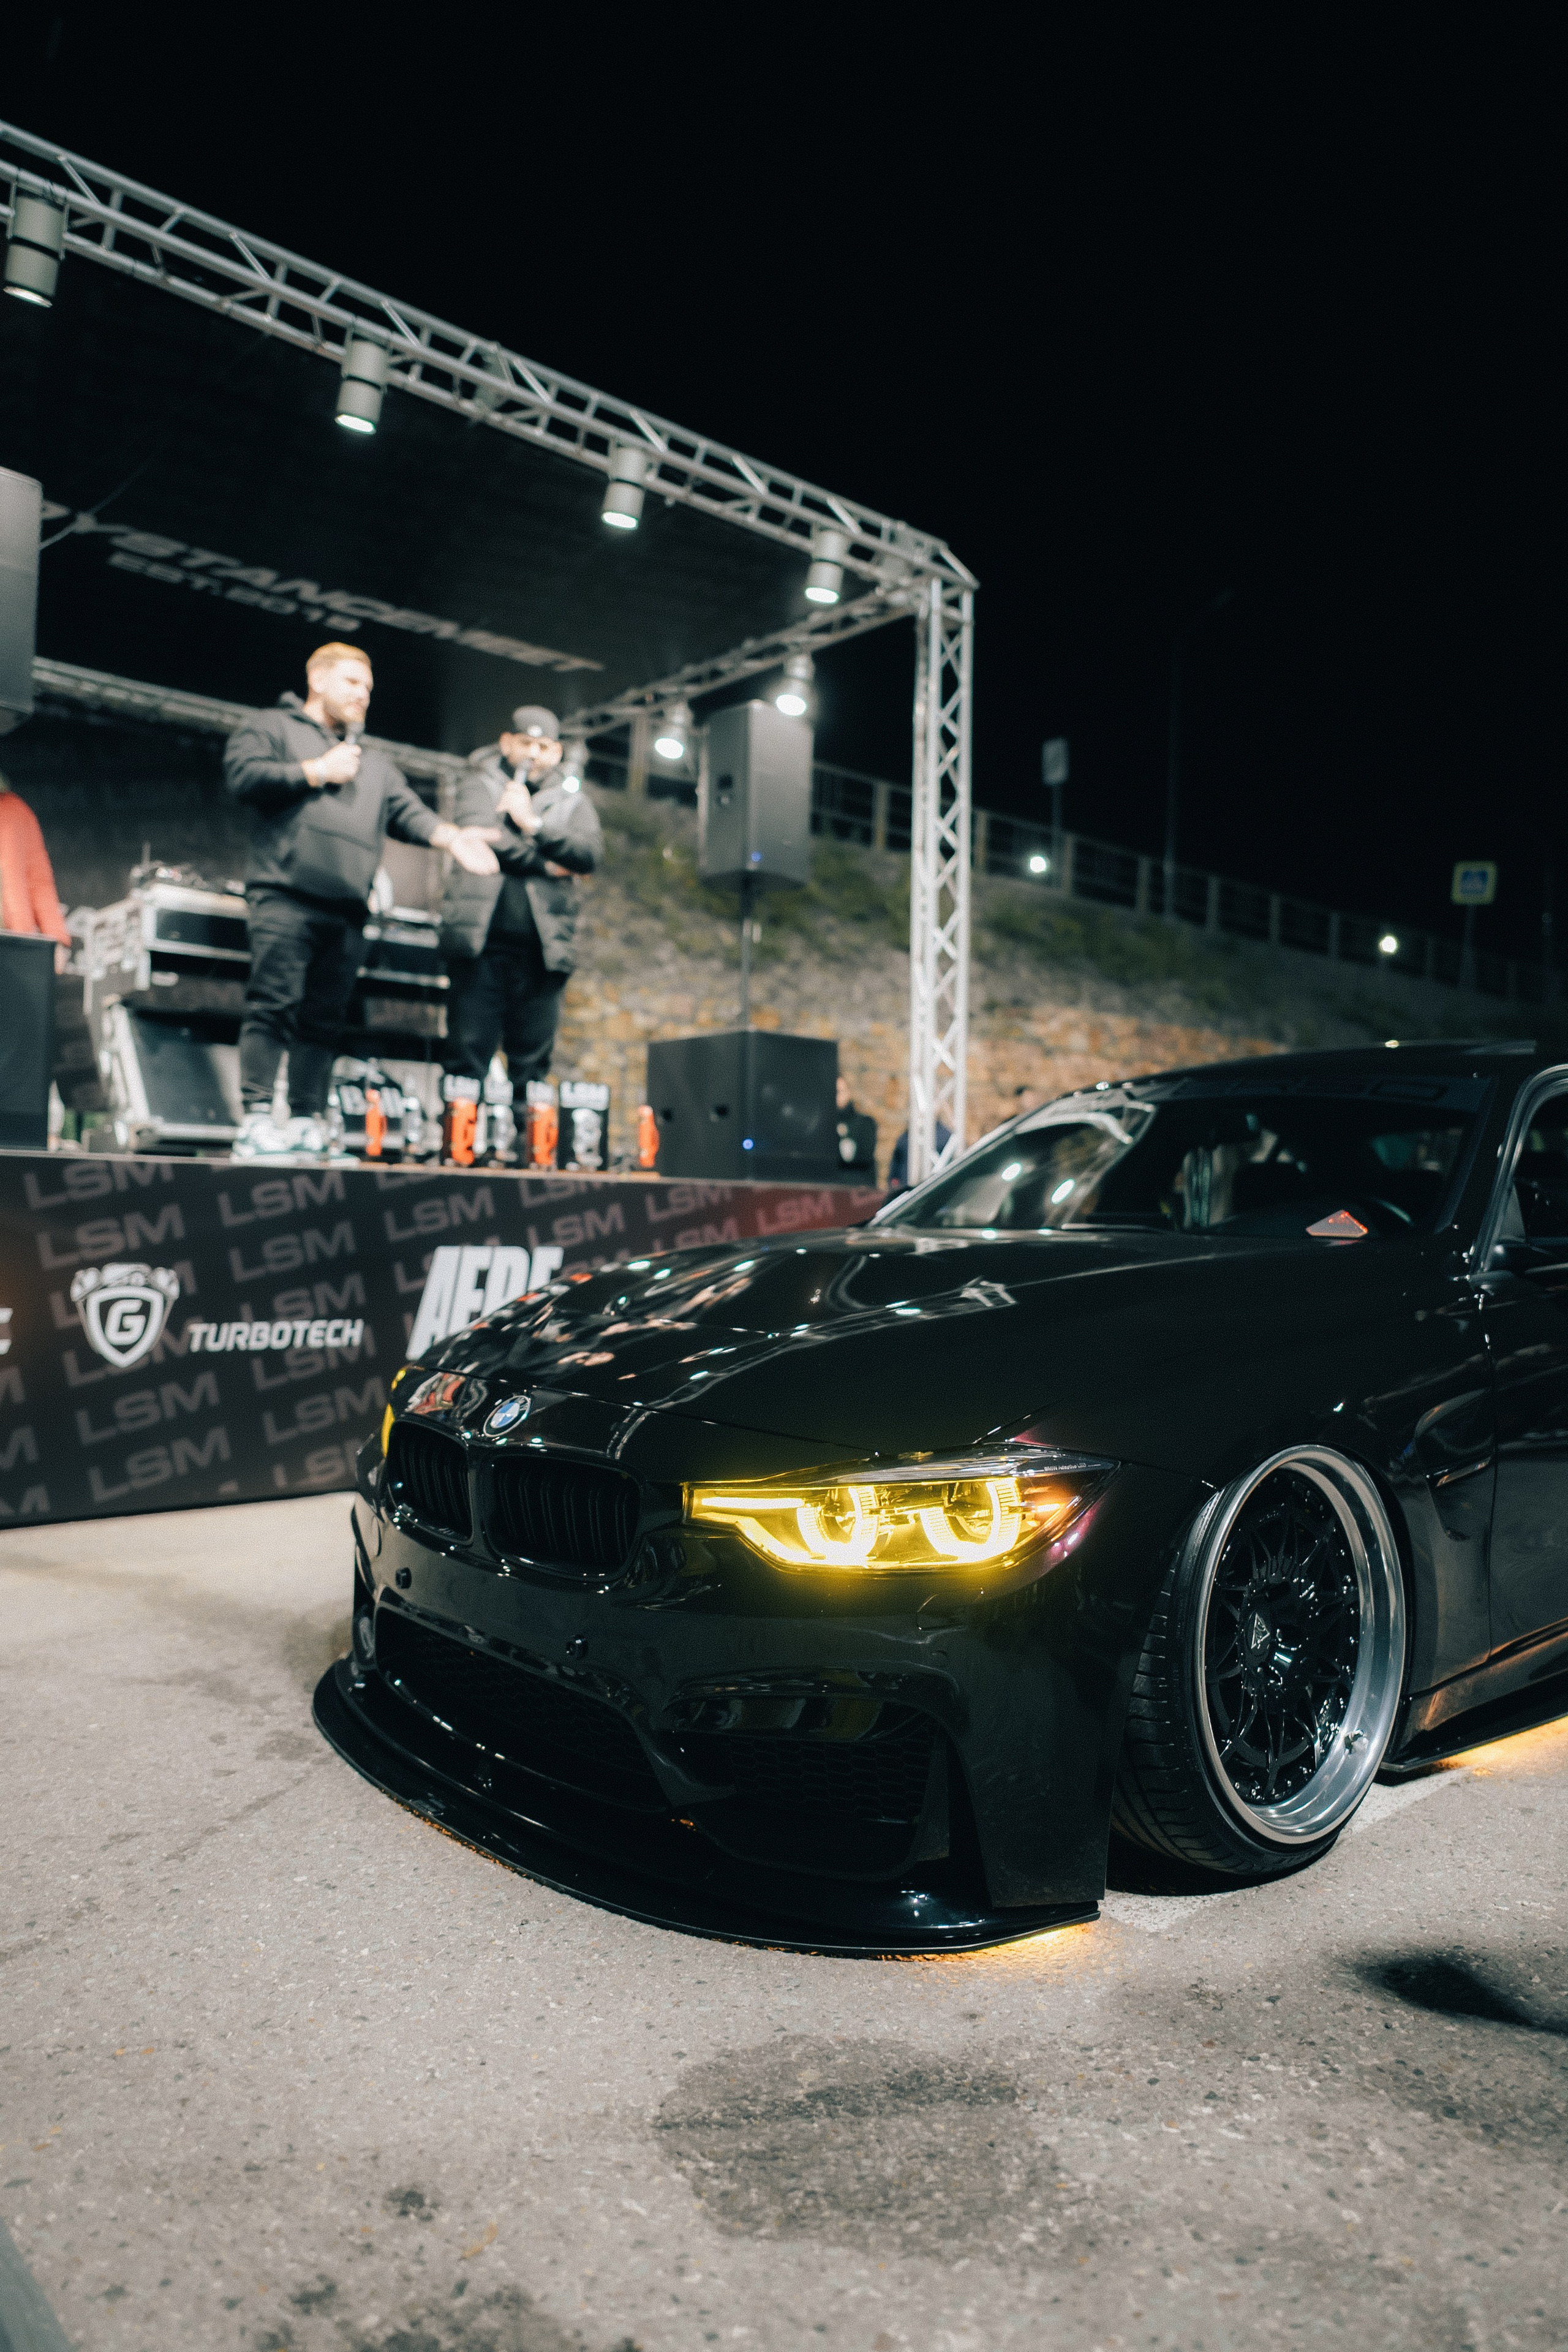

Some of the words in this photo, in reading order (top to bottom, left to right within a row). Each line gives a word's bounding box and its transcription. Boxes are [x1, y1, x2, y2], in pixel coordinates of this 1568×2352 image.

[24, 1161, 173, 1210] LSM
[217, 1170, 346, 1227] LSM
[383, 1186, 495, 1241] LSM
[646, 1185, 733, 1221] LSM
[756, 1192, 835, 1235] LSM
[36, 1204, 185, 1270] LSM
[229, 1221, 356, 1282] LSM
[105, 1299, 146, 1346] G
[187, 1319, 365, 1352] TURBOTECH
[63, 1316, 205, 1387] LM
[75, 1371, 219, 1446] LSM
[262, 1378, 387, 1445] LSM
[89, 1427, 231, 1502] LSM
